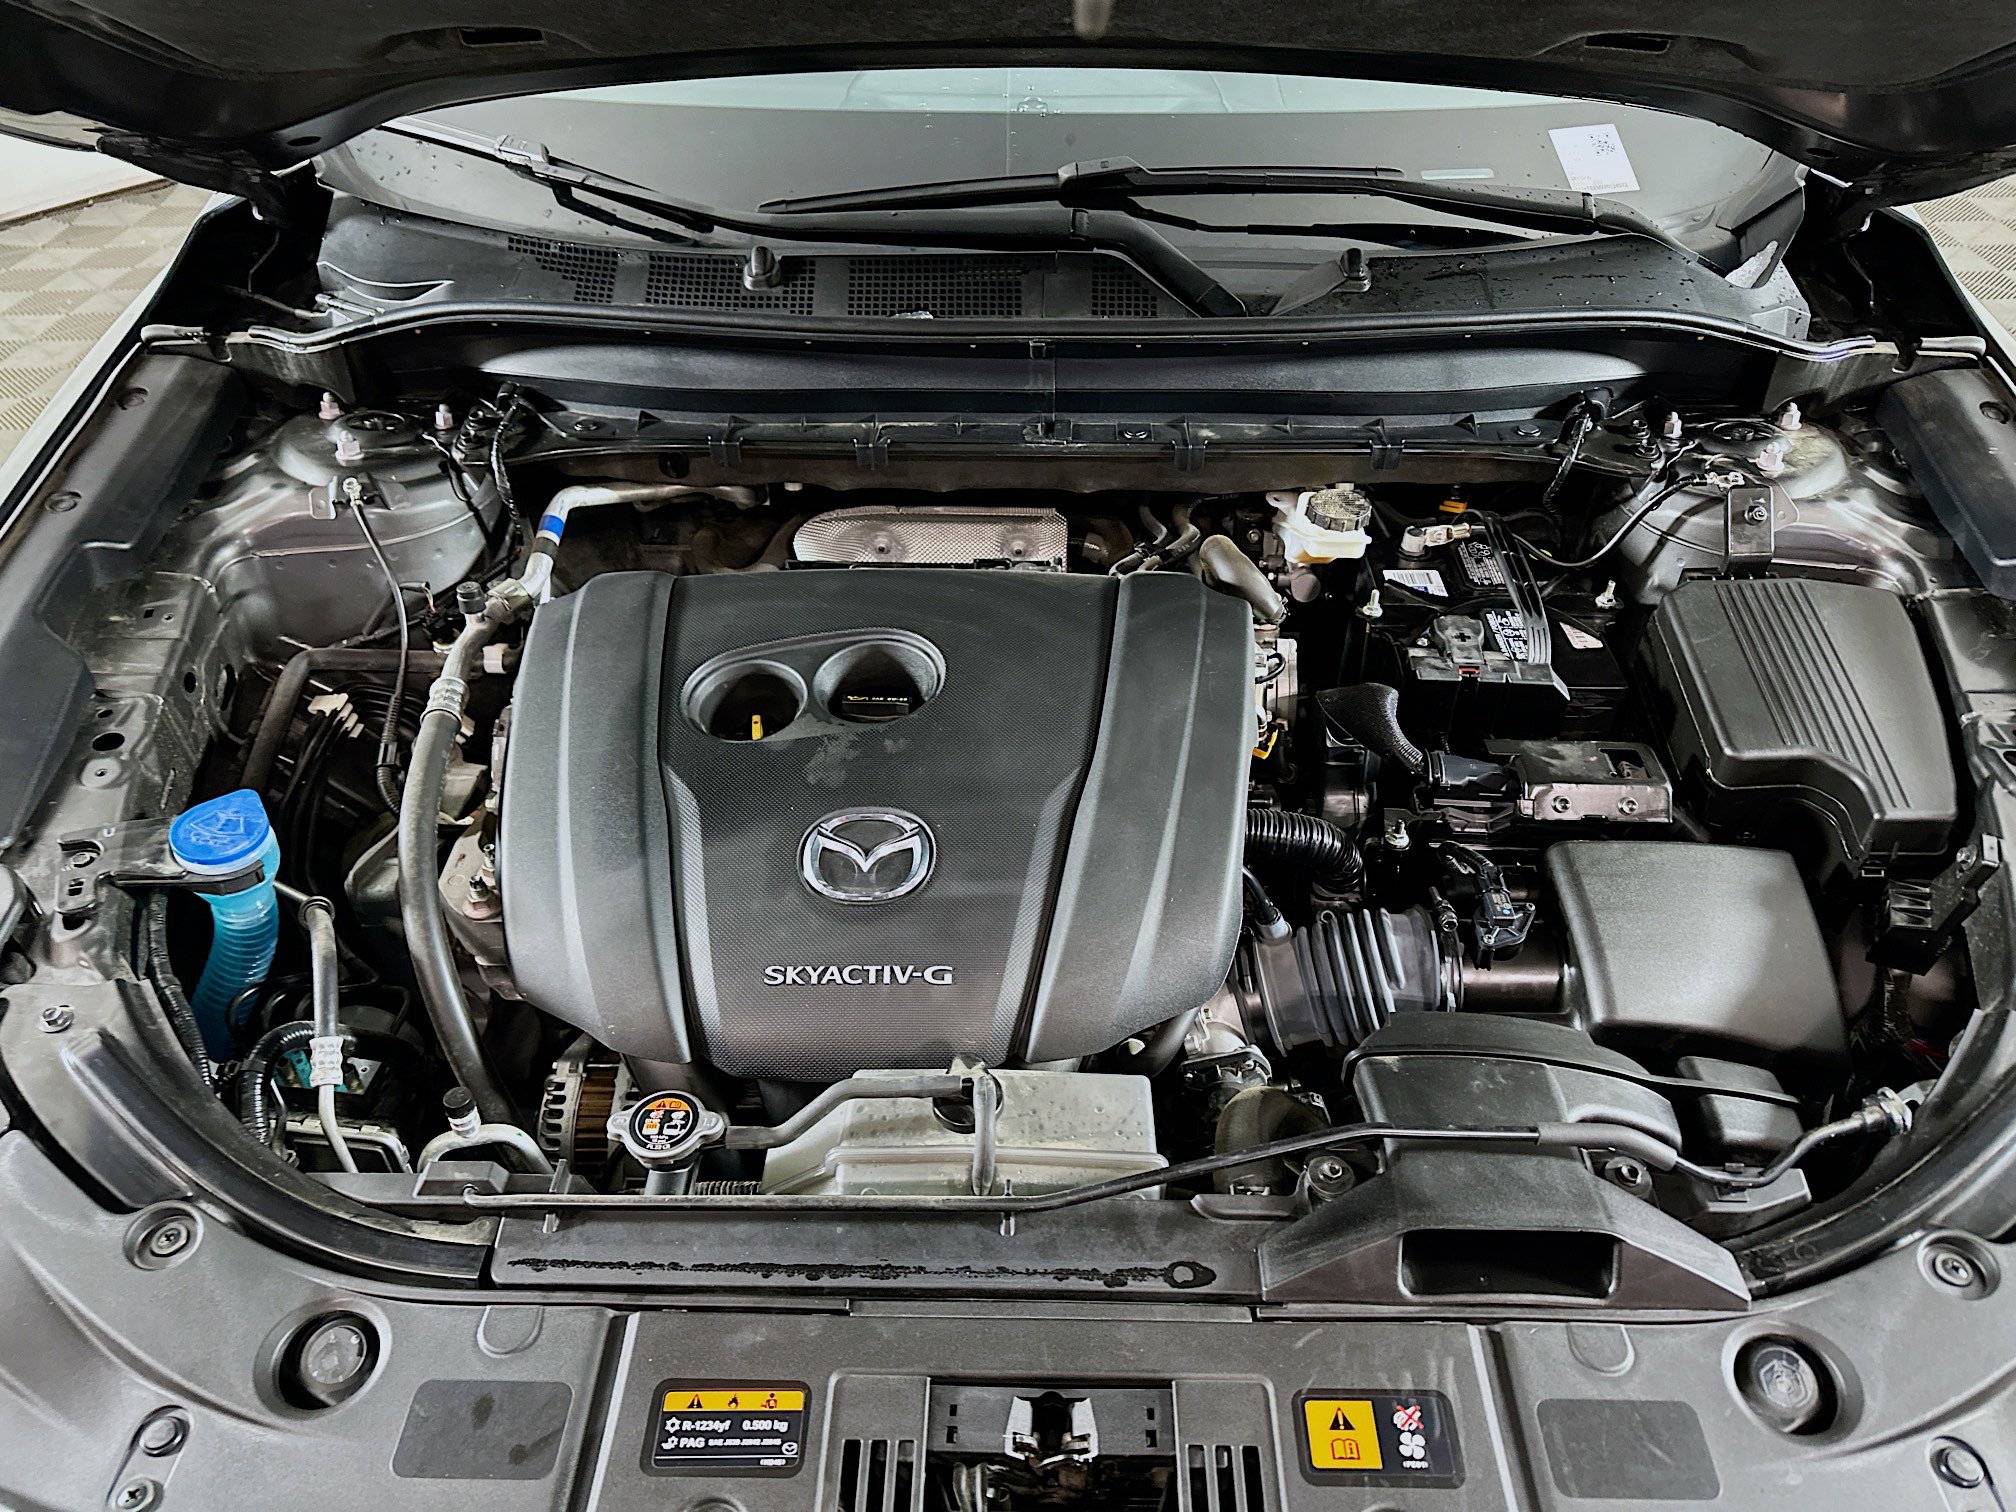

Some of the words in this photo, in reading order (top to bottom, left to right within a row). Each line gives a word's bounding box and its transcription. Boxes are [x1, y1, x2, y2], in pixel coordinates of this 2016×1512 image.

[763, 964, 953, 986] SKYACTIV-G
[681, 1419, 732, 1433] R-1234yf
[742, 1419, 772, 1431] 0.500
[772, 1419, 789, 1433] kg
[679, 1436, 706, 1448] PAG
